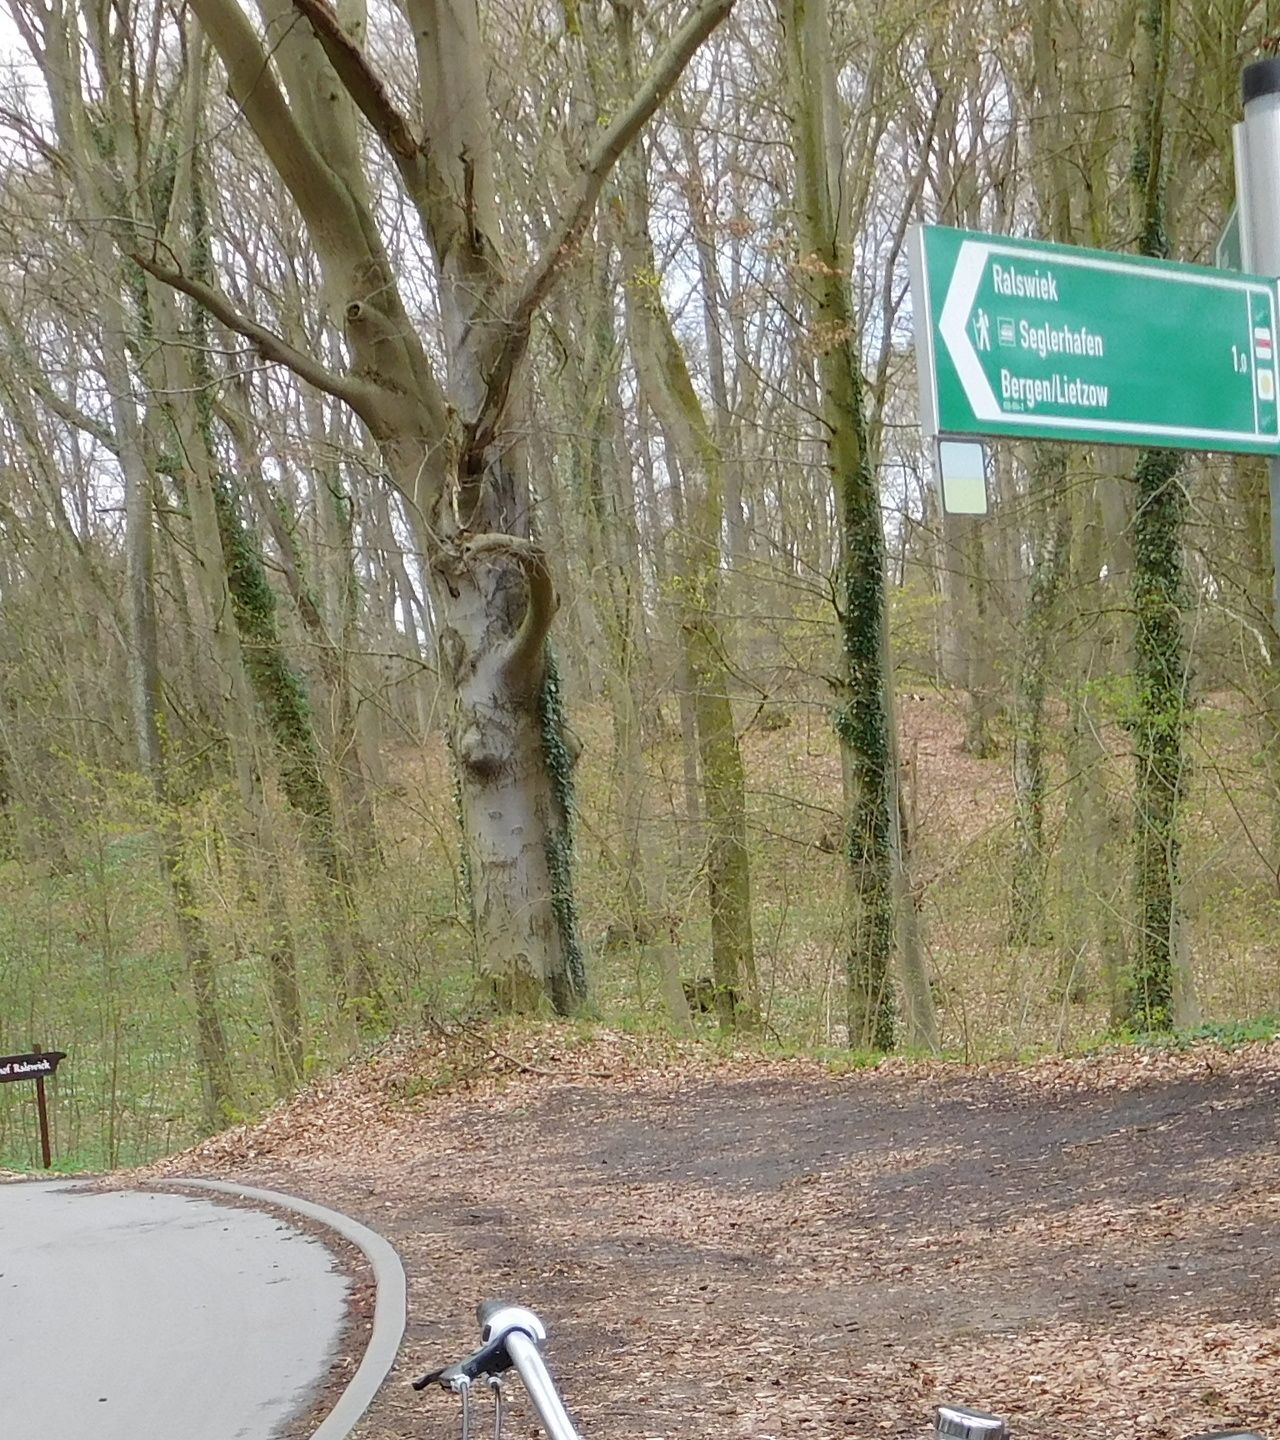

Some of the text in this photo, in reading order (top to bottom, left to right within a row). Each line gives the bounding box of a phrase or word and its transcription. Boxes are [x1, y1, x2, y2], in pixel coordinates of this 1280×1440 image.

[992, 264, 1059, 302] Ralswiek
[1019, 319, 1104, 358] Seglerhafen
[1000, 367, 1109, 409] Bergen/Lietzow
